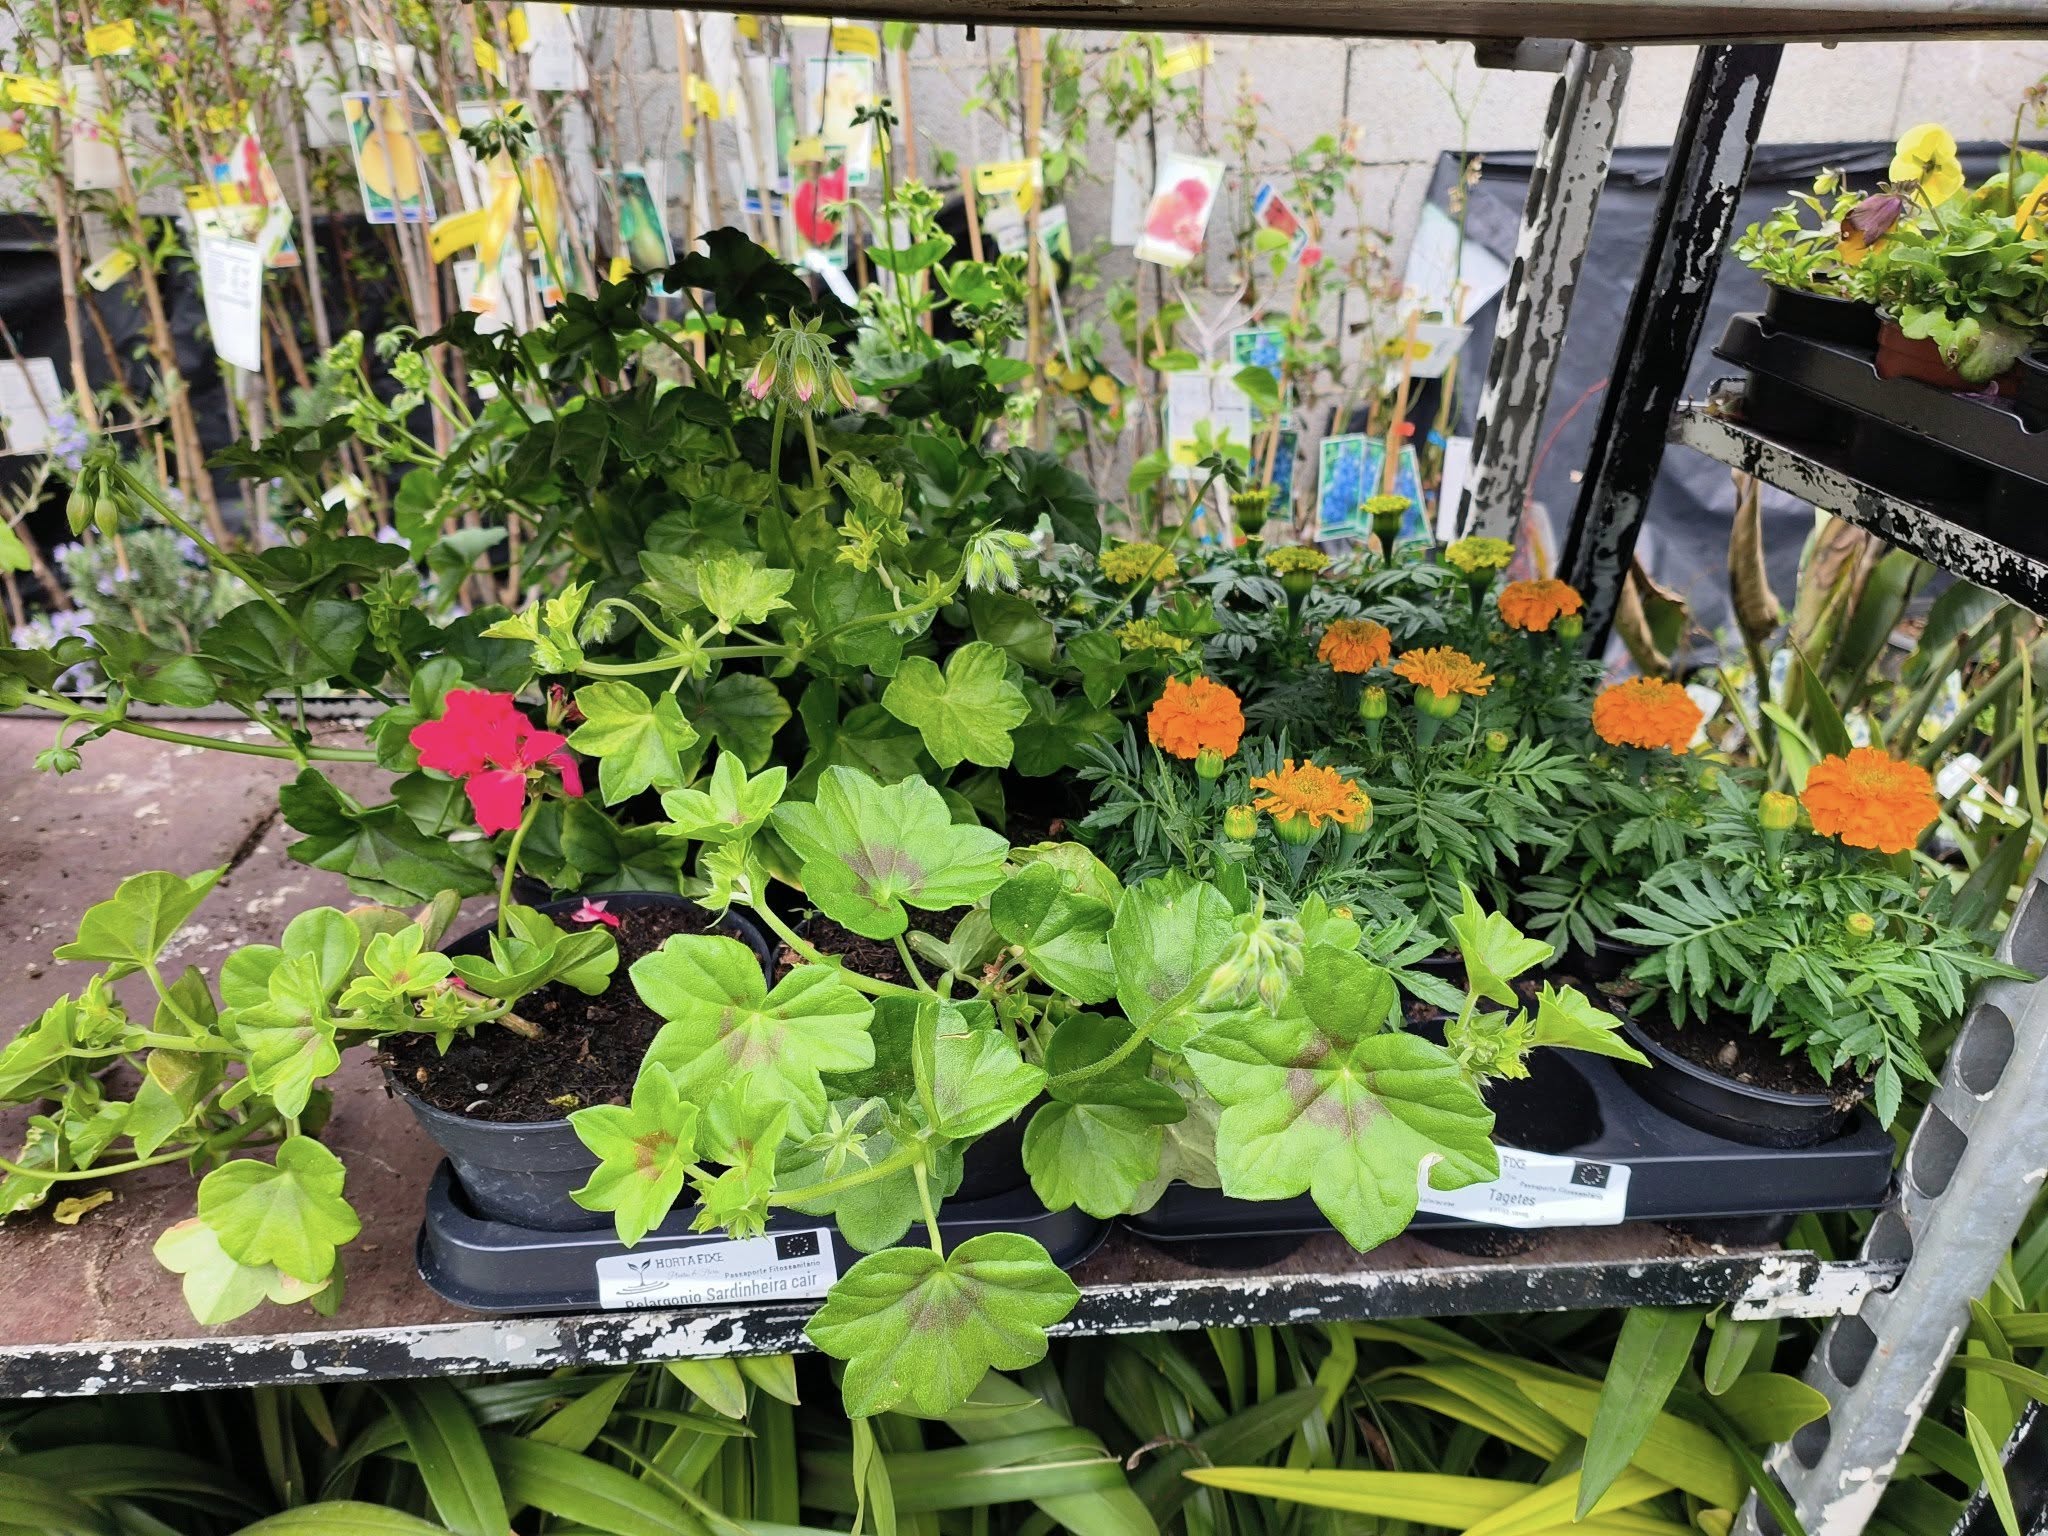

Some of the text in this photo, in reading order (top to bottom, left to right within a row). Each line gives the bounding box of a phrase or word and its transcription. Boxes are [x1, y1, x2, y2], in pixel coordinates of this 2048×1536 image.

[1488, 1188, 1536, 1206] Tagetes
[725, 1268, 767, 1279] Passaporte
[706, 1277, 787, 1301] Sardinheira
[791, 1271, 817, 1290] cair
